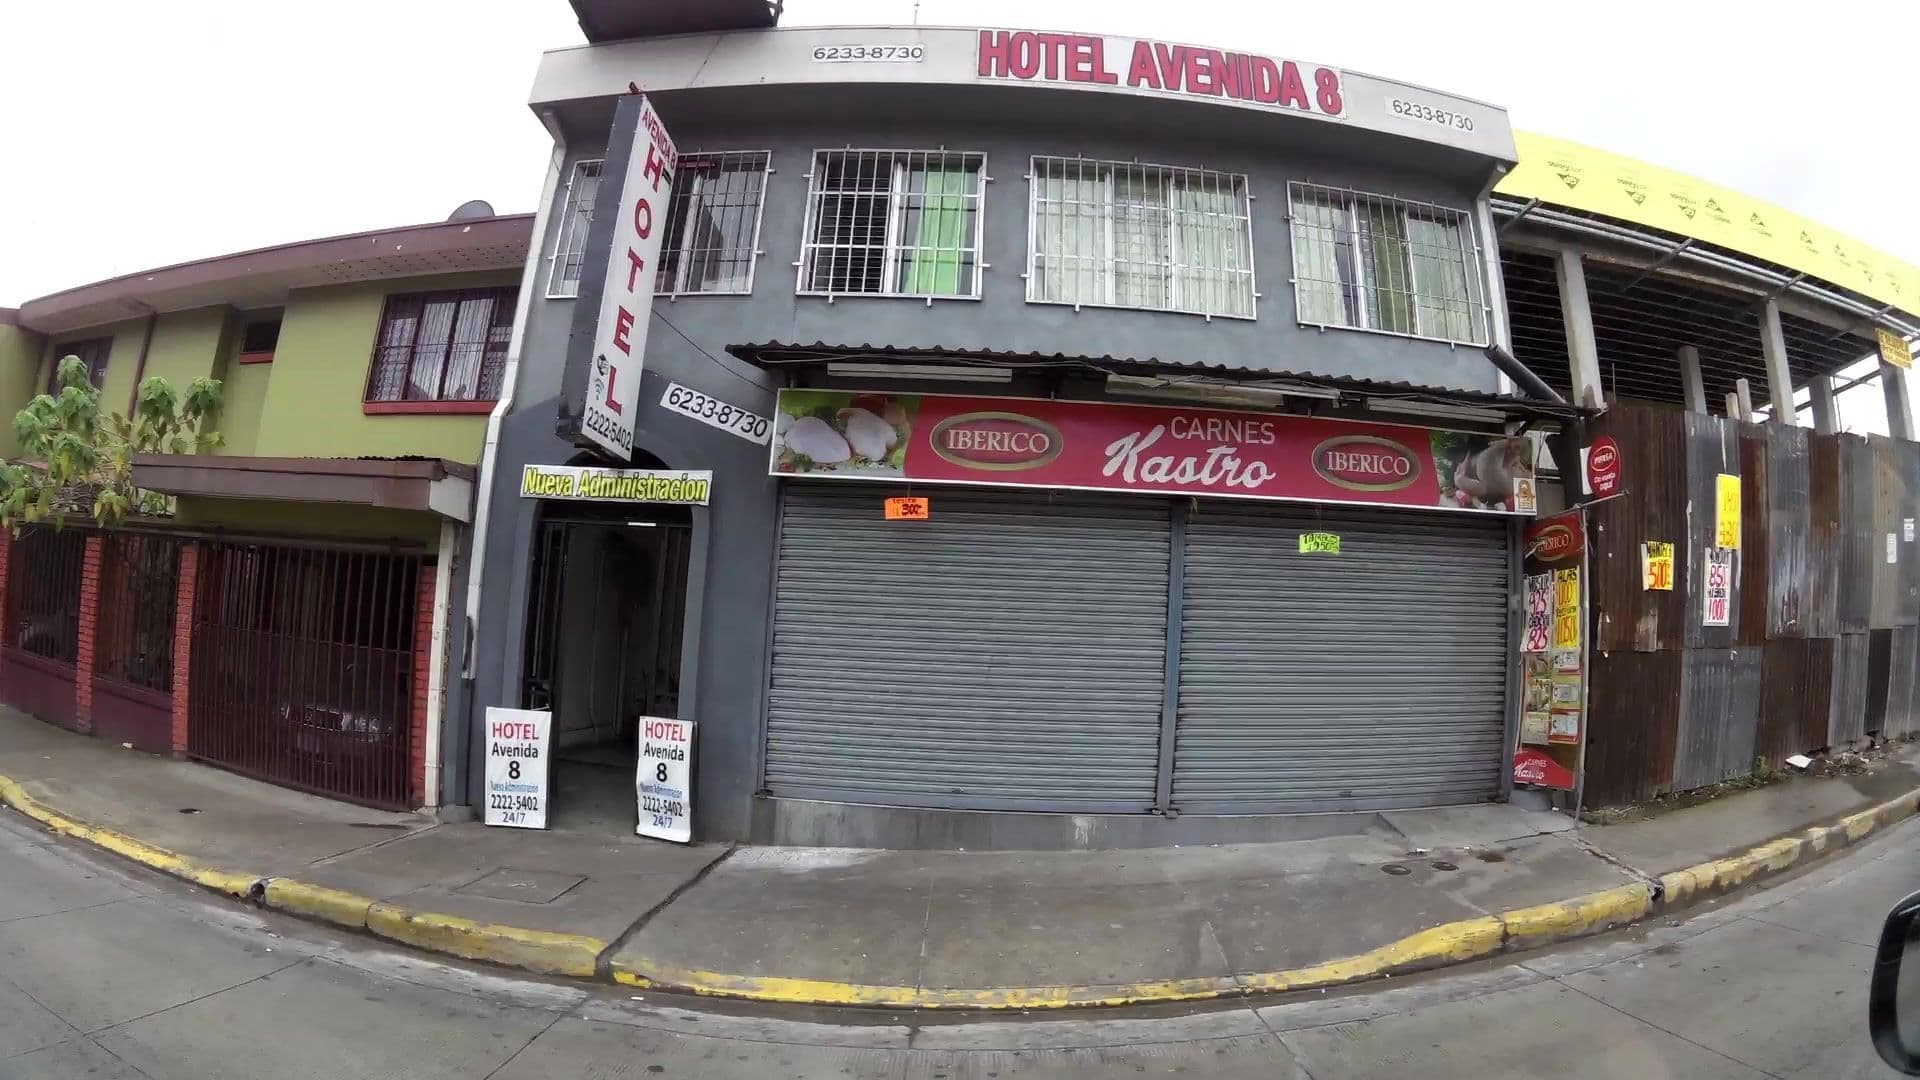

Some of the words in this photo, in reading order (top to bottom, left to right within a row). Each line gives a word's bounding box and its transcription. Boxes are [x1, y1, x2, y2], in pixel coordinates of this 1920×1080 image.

[813, 46, 923, 60] 6233-8730
[978, 29, 1118, 85] HOTEL
[1127, 40, 1311, 110] AVENIDA
[1314, 67, 1343, 115] 8
[1391, 98, 1474, 132] 6233-8730
[642, 111, 670, 164] AVENIDA
[670, 151, 677, 170] 8
[605, 142, 665, 417] HOTEL
[668, 386, 768, 438] 6233-8730
[586, 406, 633, 451] 2222-5402
[1170, 416, 1276, 445] CARNES
[946, 429, 1050, 454] IBERICO
[1102, 424, 1277, 488] Kastro
[1326, 451, 1410, 476] IBERICO
[523, 468, 574, 496] Nueva
[577, 469, 709, 501] Administracion
[491, 722, 540, 740] HOTEL
[644, 720, 687, 742] HOTEL
[491, 742, 539, 758] Avenida
[643, 742, 685, 761] Avenida
[508, 760, 521, 779] 8
[656, 762, 668, 782] 8
[491, 794, 539, 811] 2222-5402
[642, 795, 684, 817] 2222-5402
[502, 812, 526, 824] 24/7
[652, 814, 673, 829] 24/7
